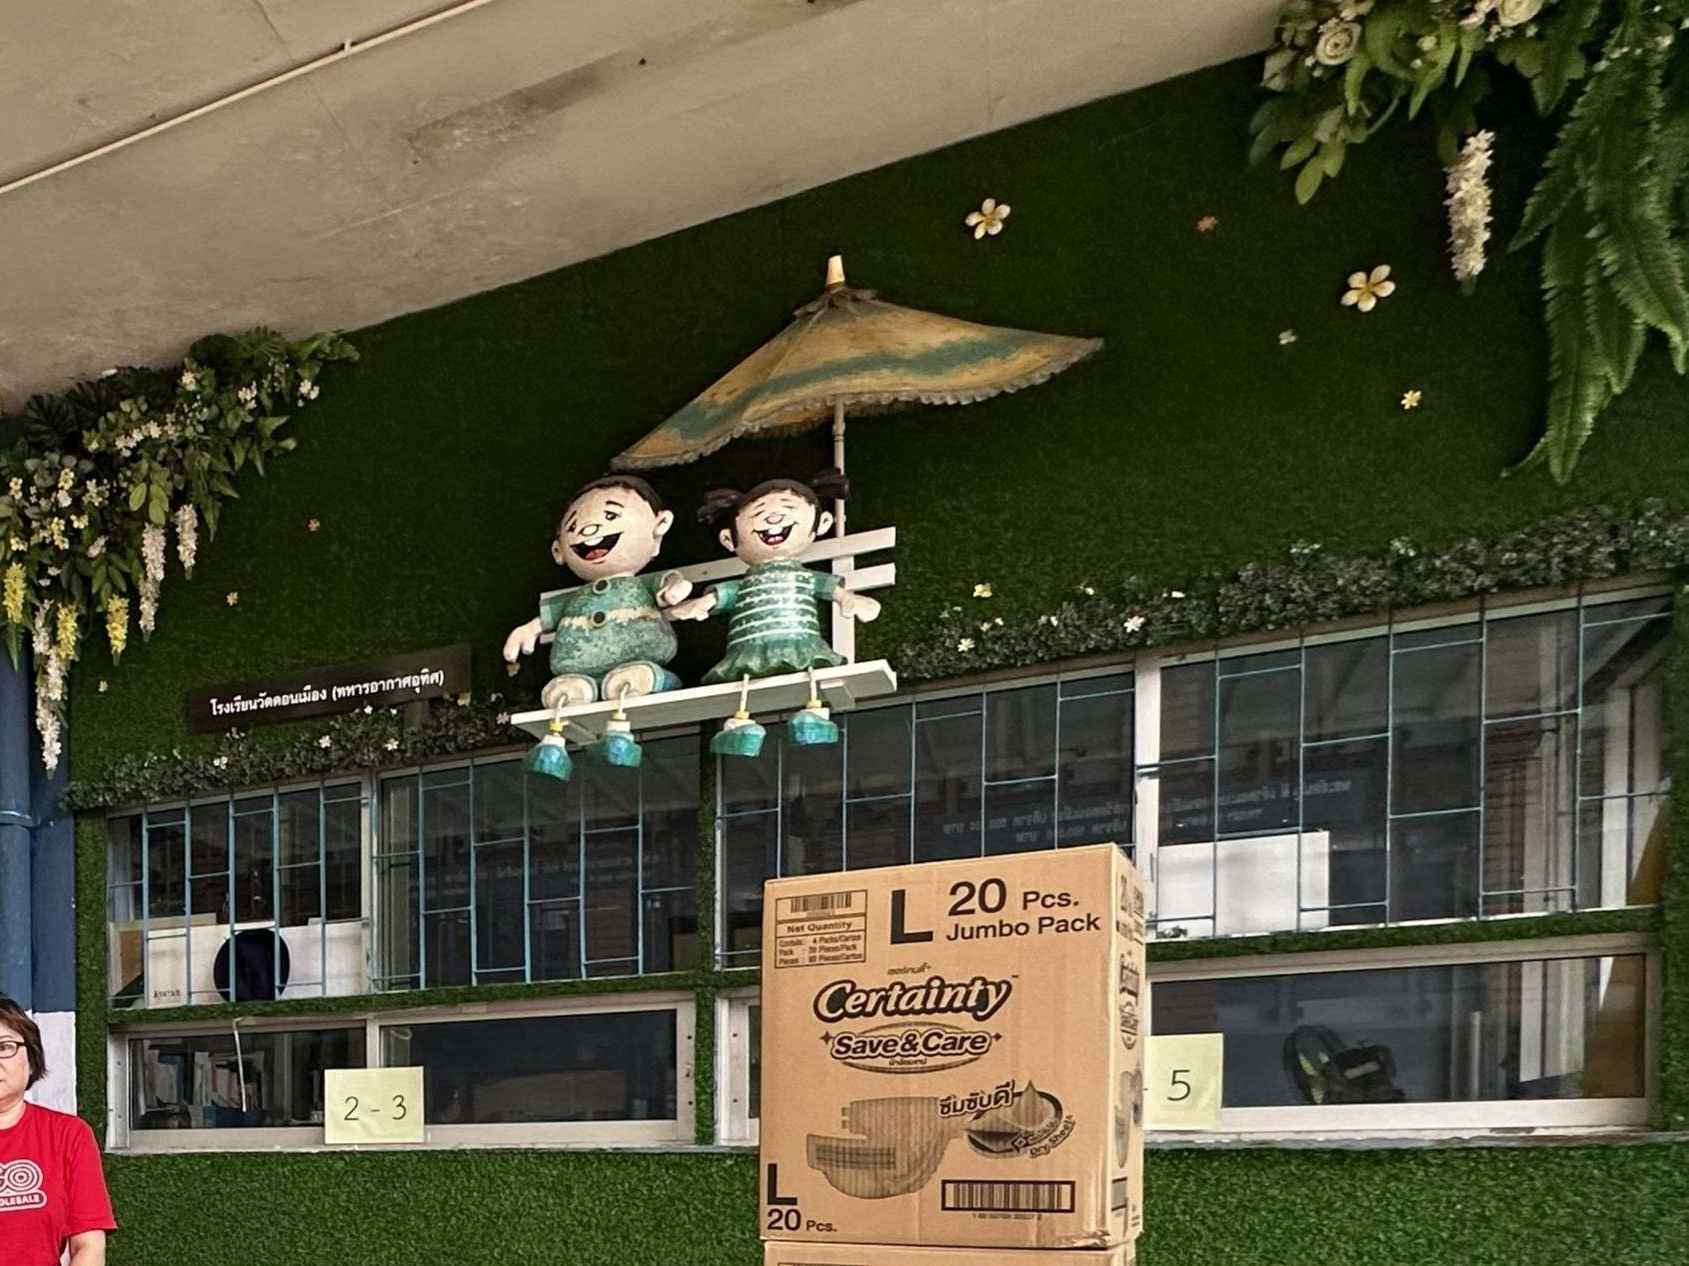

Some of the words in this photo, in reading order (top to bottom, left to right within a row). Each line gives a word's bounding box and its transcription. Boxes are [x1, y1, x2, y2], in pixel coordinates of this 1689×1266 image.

[210, 685, 327, 716] โรงเรียนวัดดอนเมือง
[331, 667, 444, 701] (ทหารอากาศอุทิศ)
[889, 889, 933, 945] L
[947, 878, 1007, 917] 20
[1022, 891, 1079, 910] Pcs.
[787, 925, 804, 933] Net
[807, 921, 853, 931] Quantity
[946, 920, 1029, 942] Jumbo
[1037, 914, 1100, 935] Pack
[815, 977, 1011, 1021] Certainty
[834, 1029, 988, 1056] Save&Care
[1167, 1069, 1192, 1101] 5
[344, 1096, 359, 1121] 2
[392, 1094, 407, 1120] 3
[767, 1163, 798, 1206] L
[766, 1209, 802, 1232] 20
[806, 1219, 837, 1232] Pcs.
